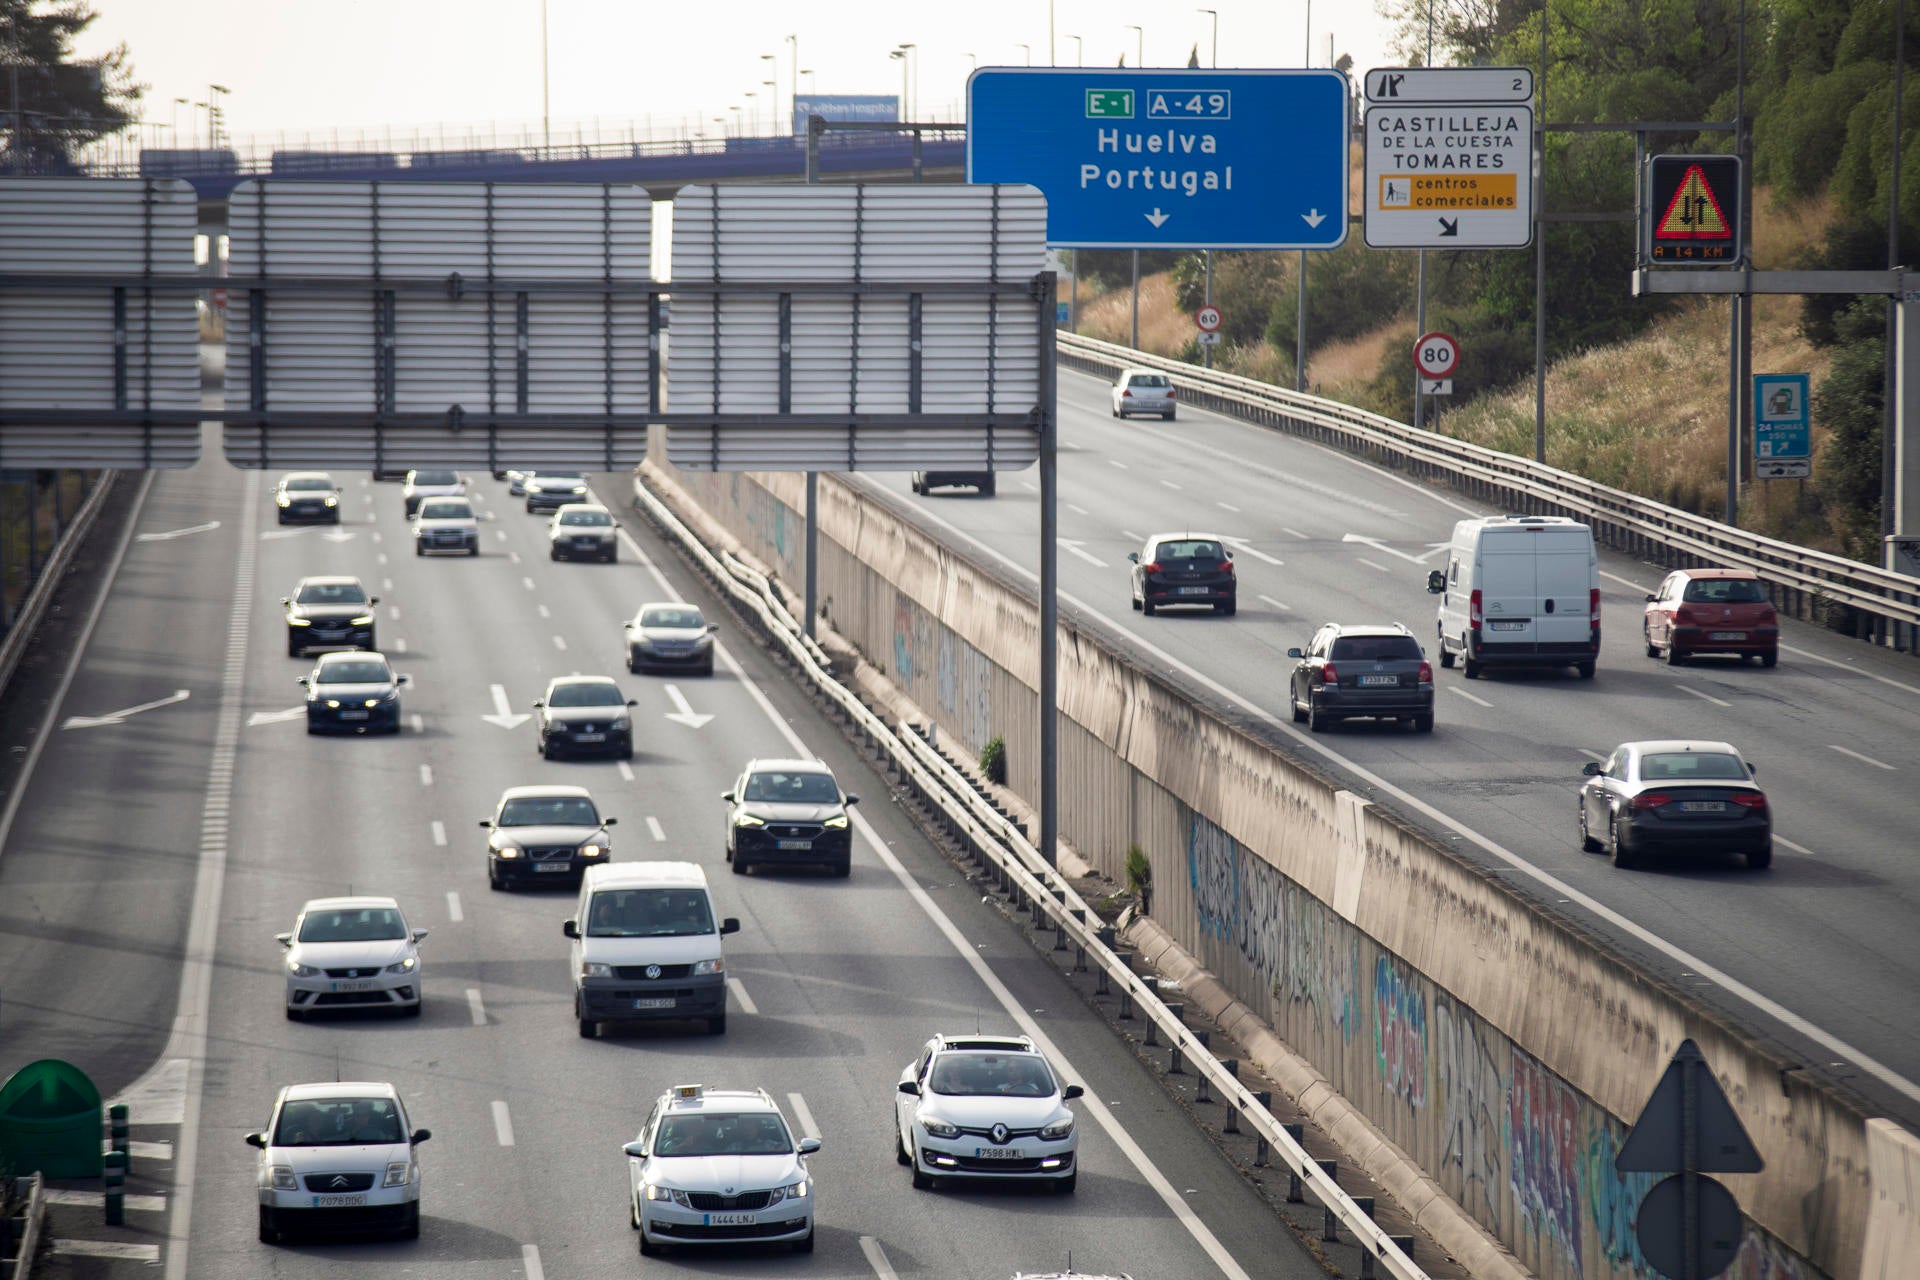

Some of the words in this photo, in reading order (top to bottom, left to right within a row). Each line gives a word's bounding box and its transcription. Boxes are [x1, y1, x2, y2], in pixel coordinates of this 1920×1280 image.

[1512, 79, 1522, 90] 2
[1090, 94, 1130, 113] E-1
[1151, 95, 1225, 114] A-49
[1378, 117, 1518, 132] CASTILLEJA
[1098, 129, 1216, 153] Huelva
[1383, 137, 1405, 148] DE
[1414, 136, 1435, 148] LA
[1445, 136, 1513, 148] CUESTA
[1393, 154, 1504, 169] TOMARES
[1081, 165, 1232, 196] Portugal
[1416, 178, 1477, 189] centros
[1416, 195, 1514, 206] comerciales
[1654, 246, 1664, 257] A
[1676, 247, 1692, 257] 14
[1703, 247, 1723, 258] KM
[1201, 314, 1218, 324] 60
[1424, 348, 1450, 363] 80
[1758, 423, 1772, 431] 24
[712, 1215, 734, 1224] 1444
[737, 1215, 755, 1223] LNJ
